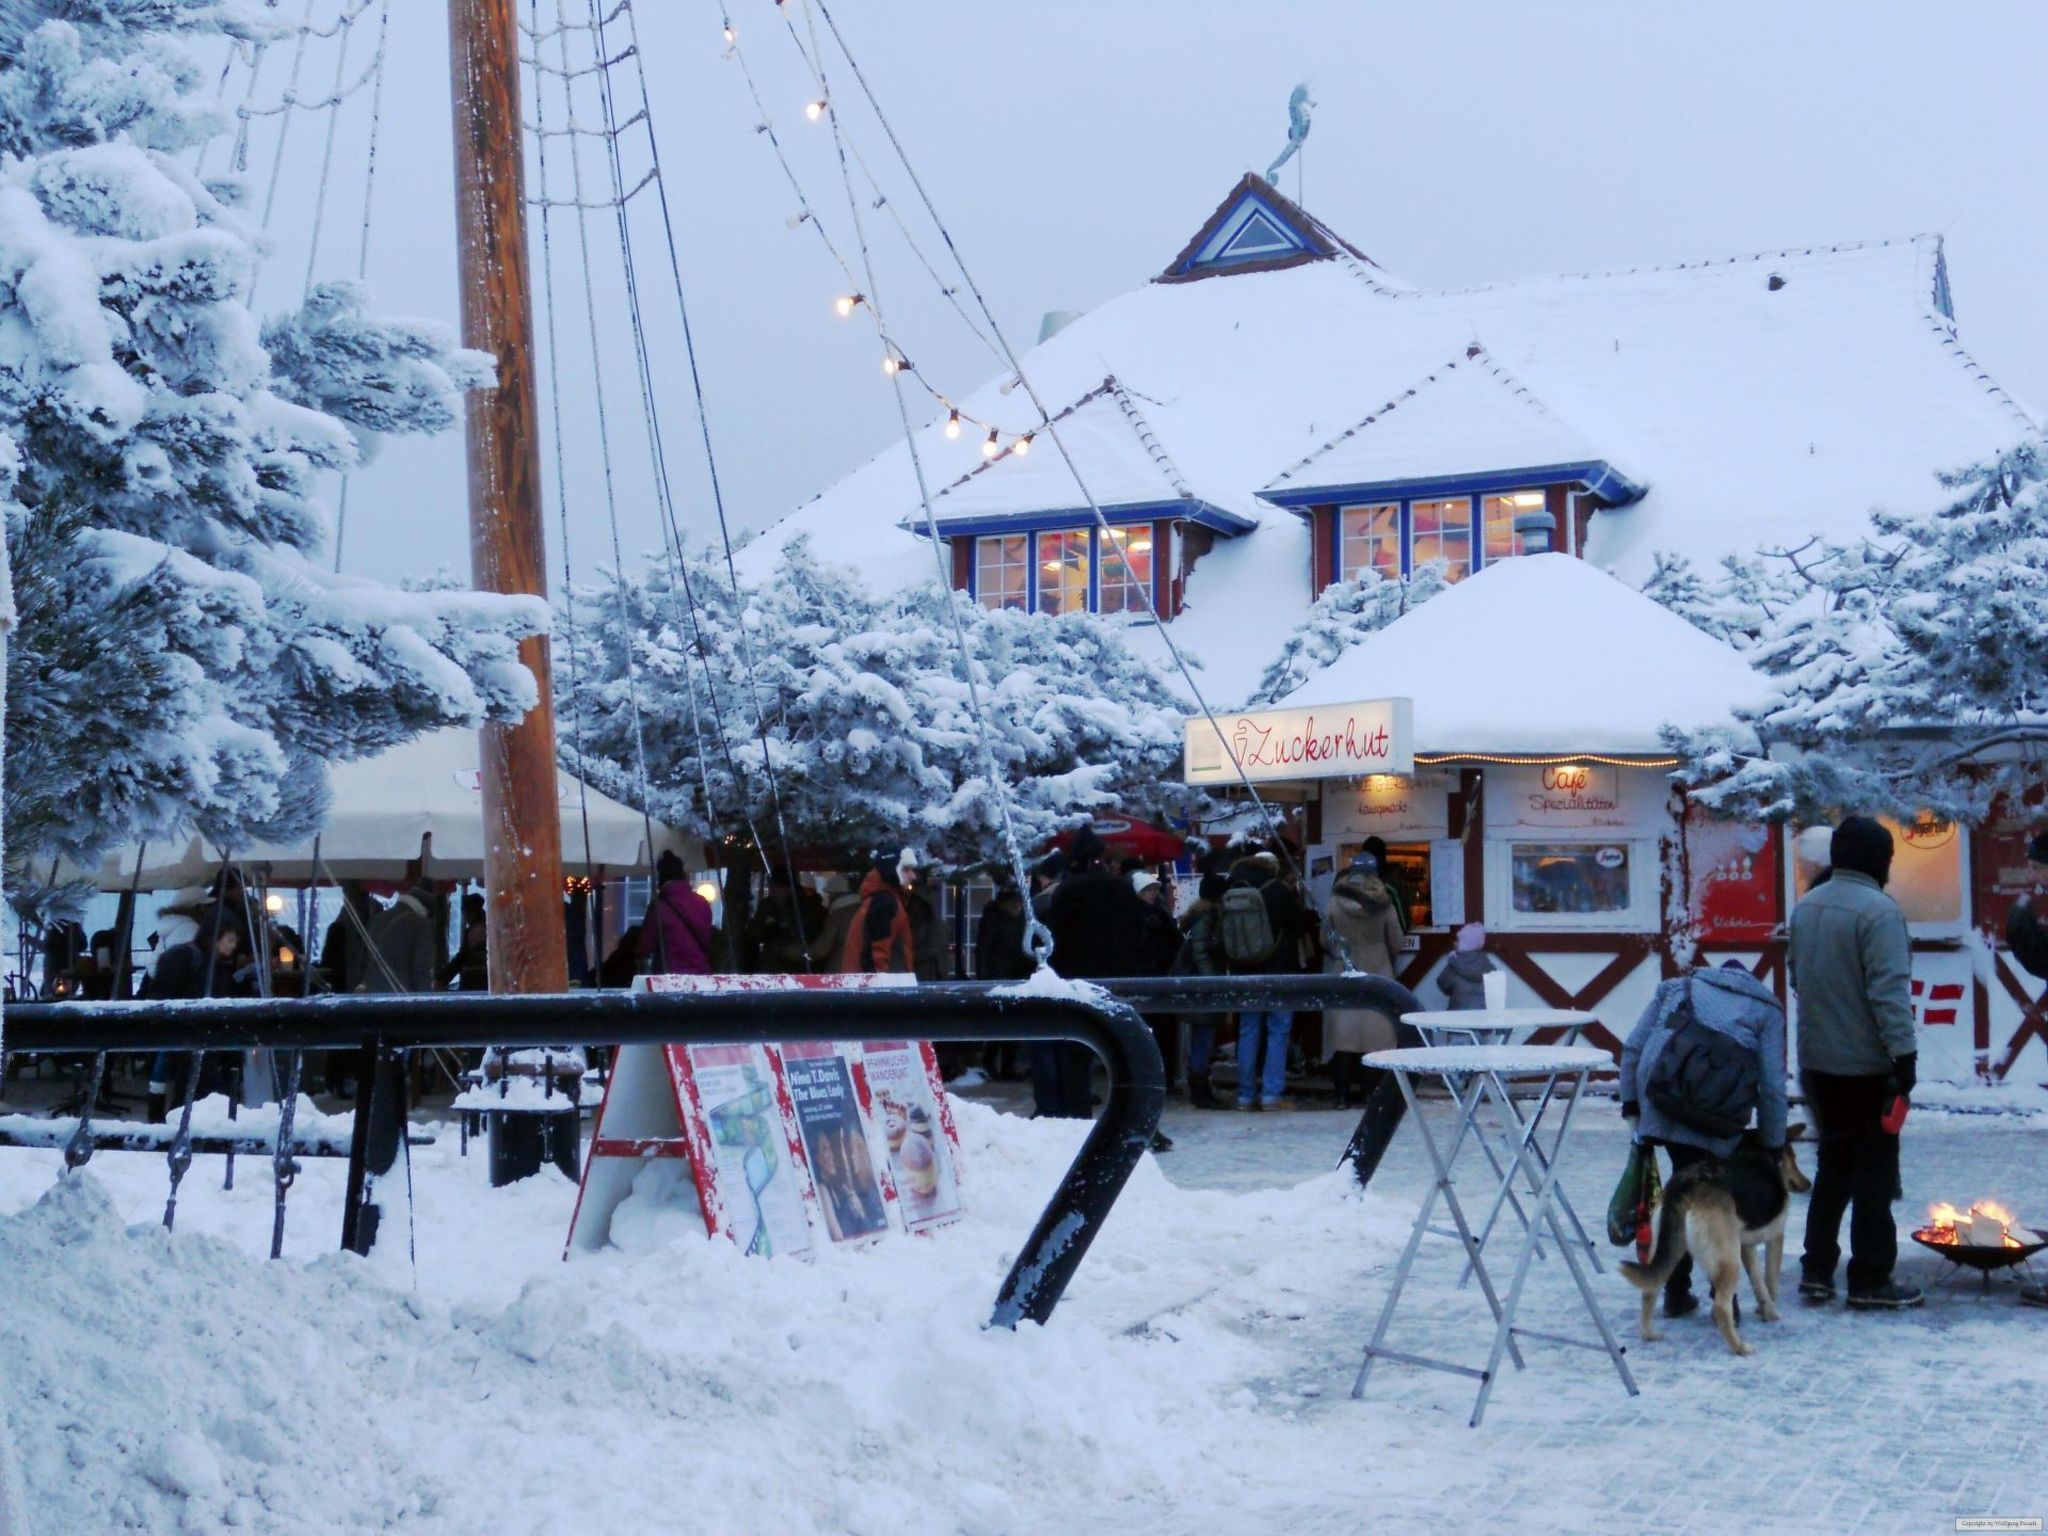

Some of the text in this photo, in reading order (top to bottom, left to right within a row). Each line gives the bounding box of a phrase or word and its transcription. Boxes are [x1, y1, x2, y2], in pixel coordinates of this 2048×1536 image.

[1242, 716, 1390, 767] Zuckerhut
[1542, 768, 1587, 798] Café
[1529, 793, 1616, 813] Spezialitäten
[793, 1087, 809, 1102] The
